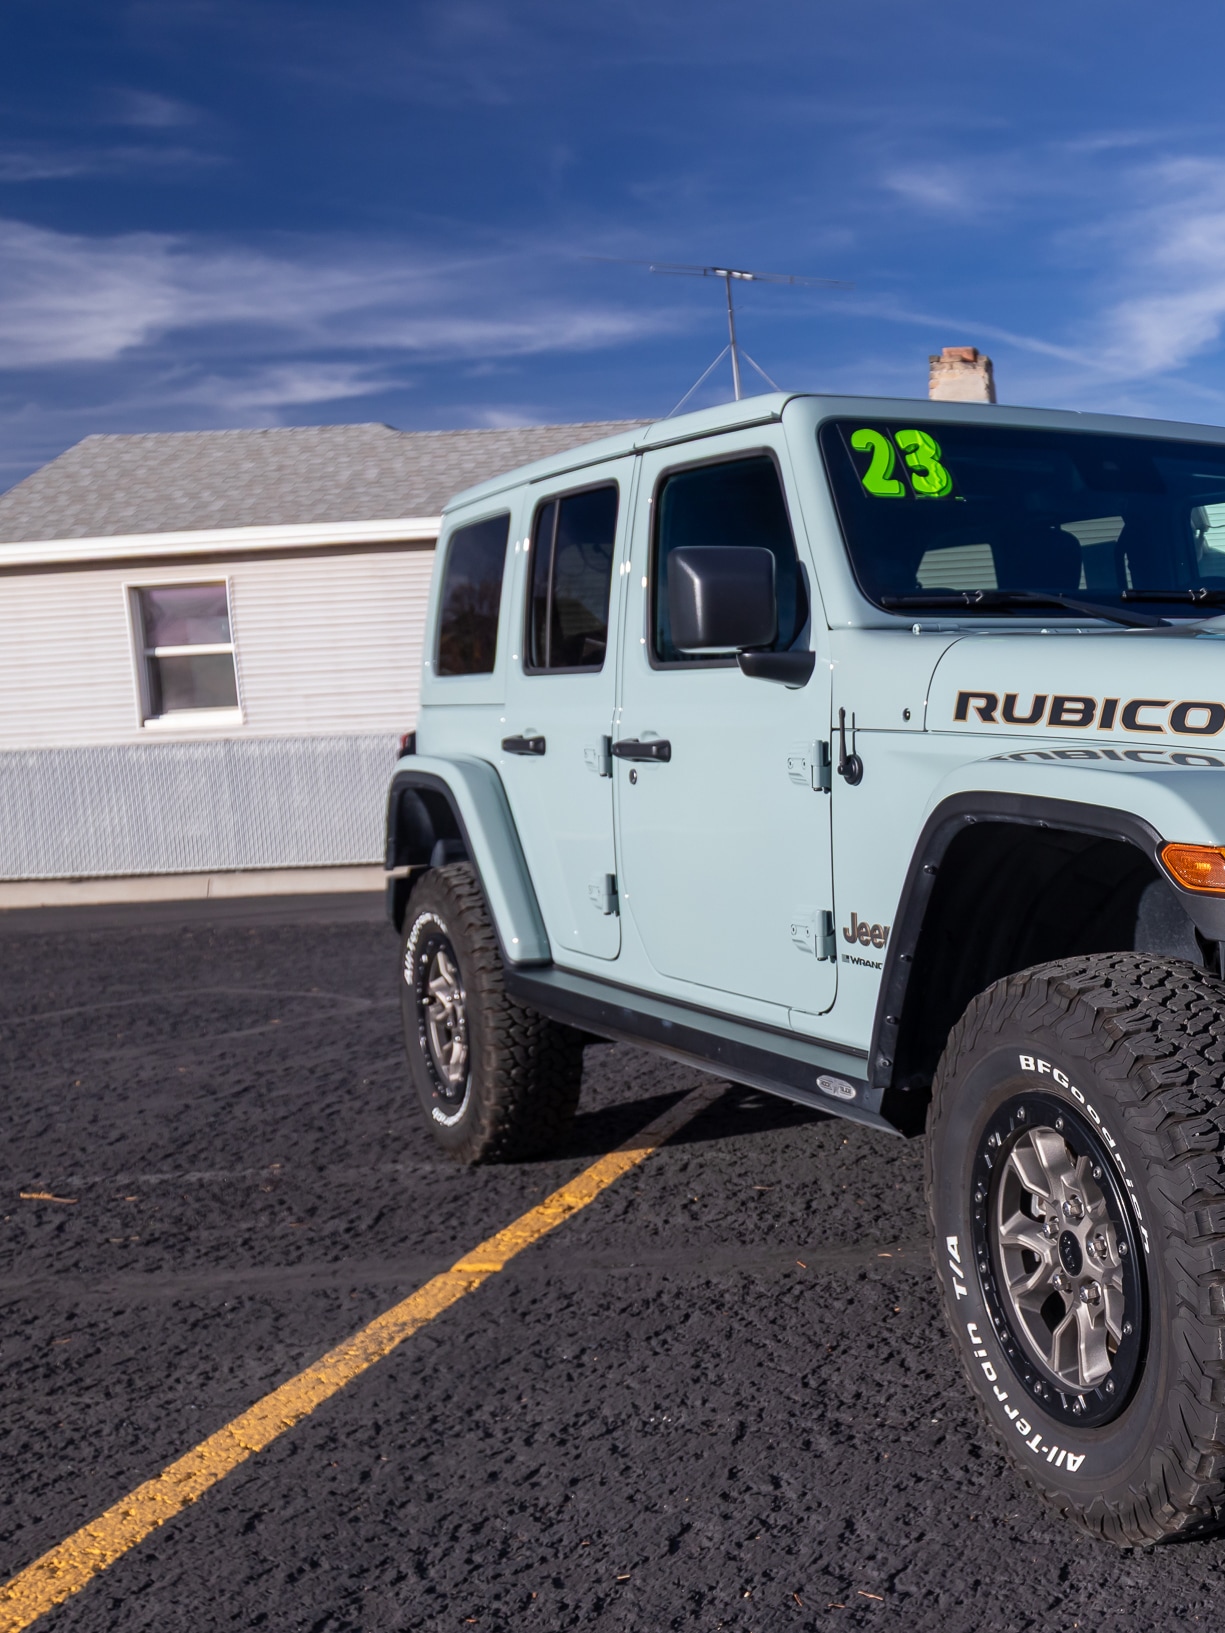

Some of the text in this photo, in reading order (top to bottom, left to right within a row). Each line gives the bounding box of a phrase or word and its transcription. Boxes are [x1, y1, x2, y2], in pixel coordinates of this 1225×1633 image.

[851, 428, 953, 498] 23
[1019, 1054, 1151, 1254] BFGoodrich
[944, 1235, 1086, 1473] All-Terrain T/A
